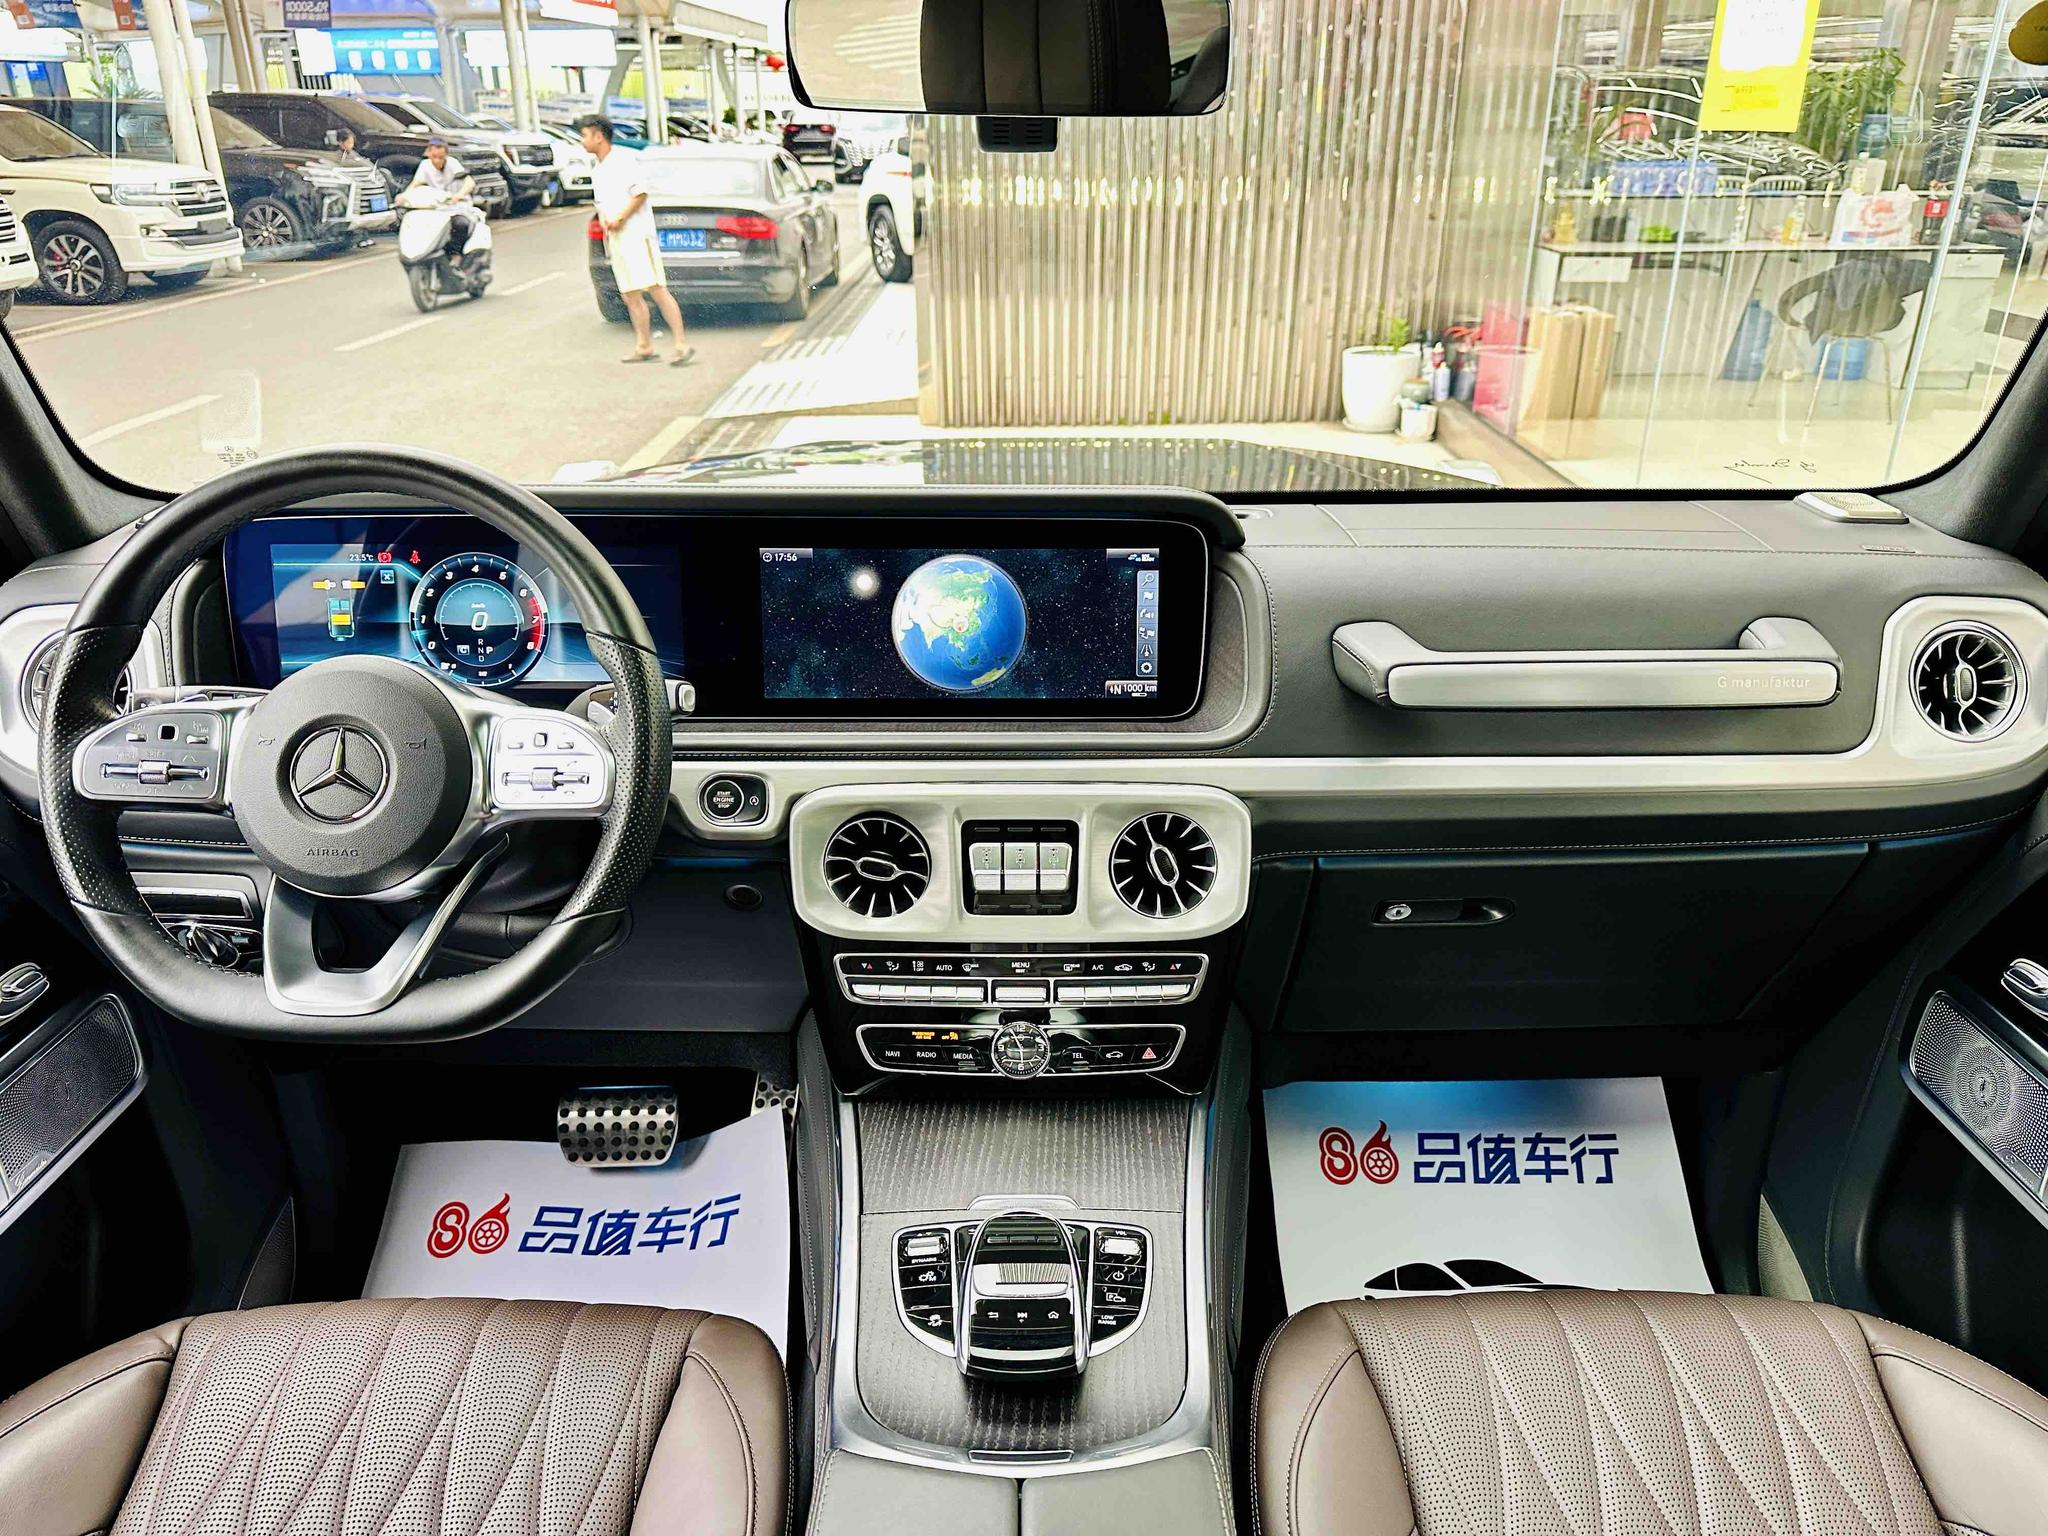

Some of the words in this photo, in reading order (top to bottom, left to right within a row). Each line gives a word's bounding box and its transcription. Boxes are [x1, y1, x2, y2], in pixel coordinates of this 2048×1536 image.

[349, 553, 374, 562] 23.5°C
[774, 552, 798, 562] 17:56
[471, 564, 480, 573] 4
[445, 571, 454, 580] 3
[499, 571, 507, 580] 5
[426, 588, 435, 597] 2
[519, 588, 528, 597] 6
[420, 615, 427, 624] 1
[471, 611, 489, 631] 0
[531, 616, 540, 624] 7
[427, 641, 436, 649] 0
[477, 638, 484, 646] R
[486, 646, 494, 654] P
[1717, 676, 1728, 688] G
[1731, 675, 1810, 688] manufaktur
[1114, 684, 1122, 694] N
[1123, 684, 1143, 692] 1000
[1144, 684, 1157, 692] km
[306, 848, 359, 857] AIRBAG
[936, 964, 953, 972] AUTO
[1011, 961, 1030, 969] MENU
[1016, 1024, 1026, 1032] 12
[998, 1044, 1005, 1052] 9
[1037, 1044, 1045, 1052] 3
[1017, 1063, 1025, 1071] 6
[1413, 1131, 1620, 1185] 品值车行
[517, 1193, 742, 1257] 品值车行
